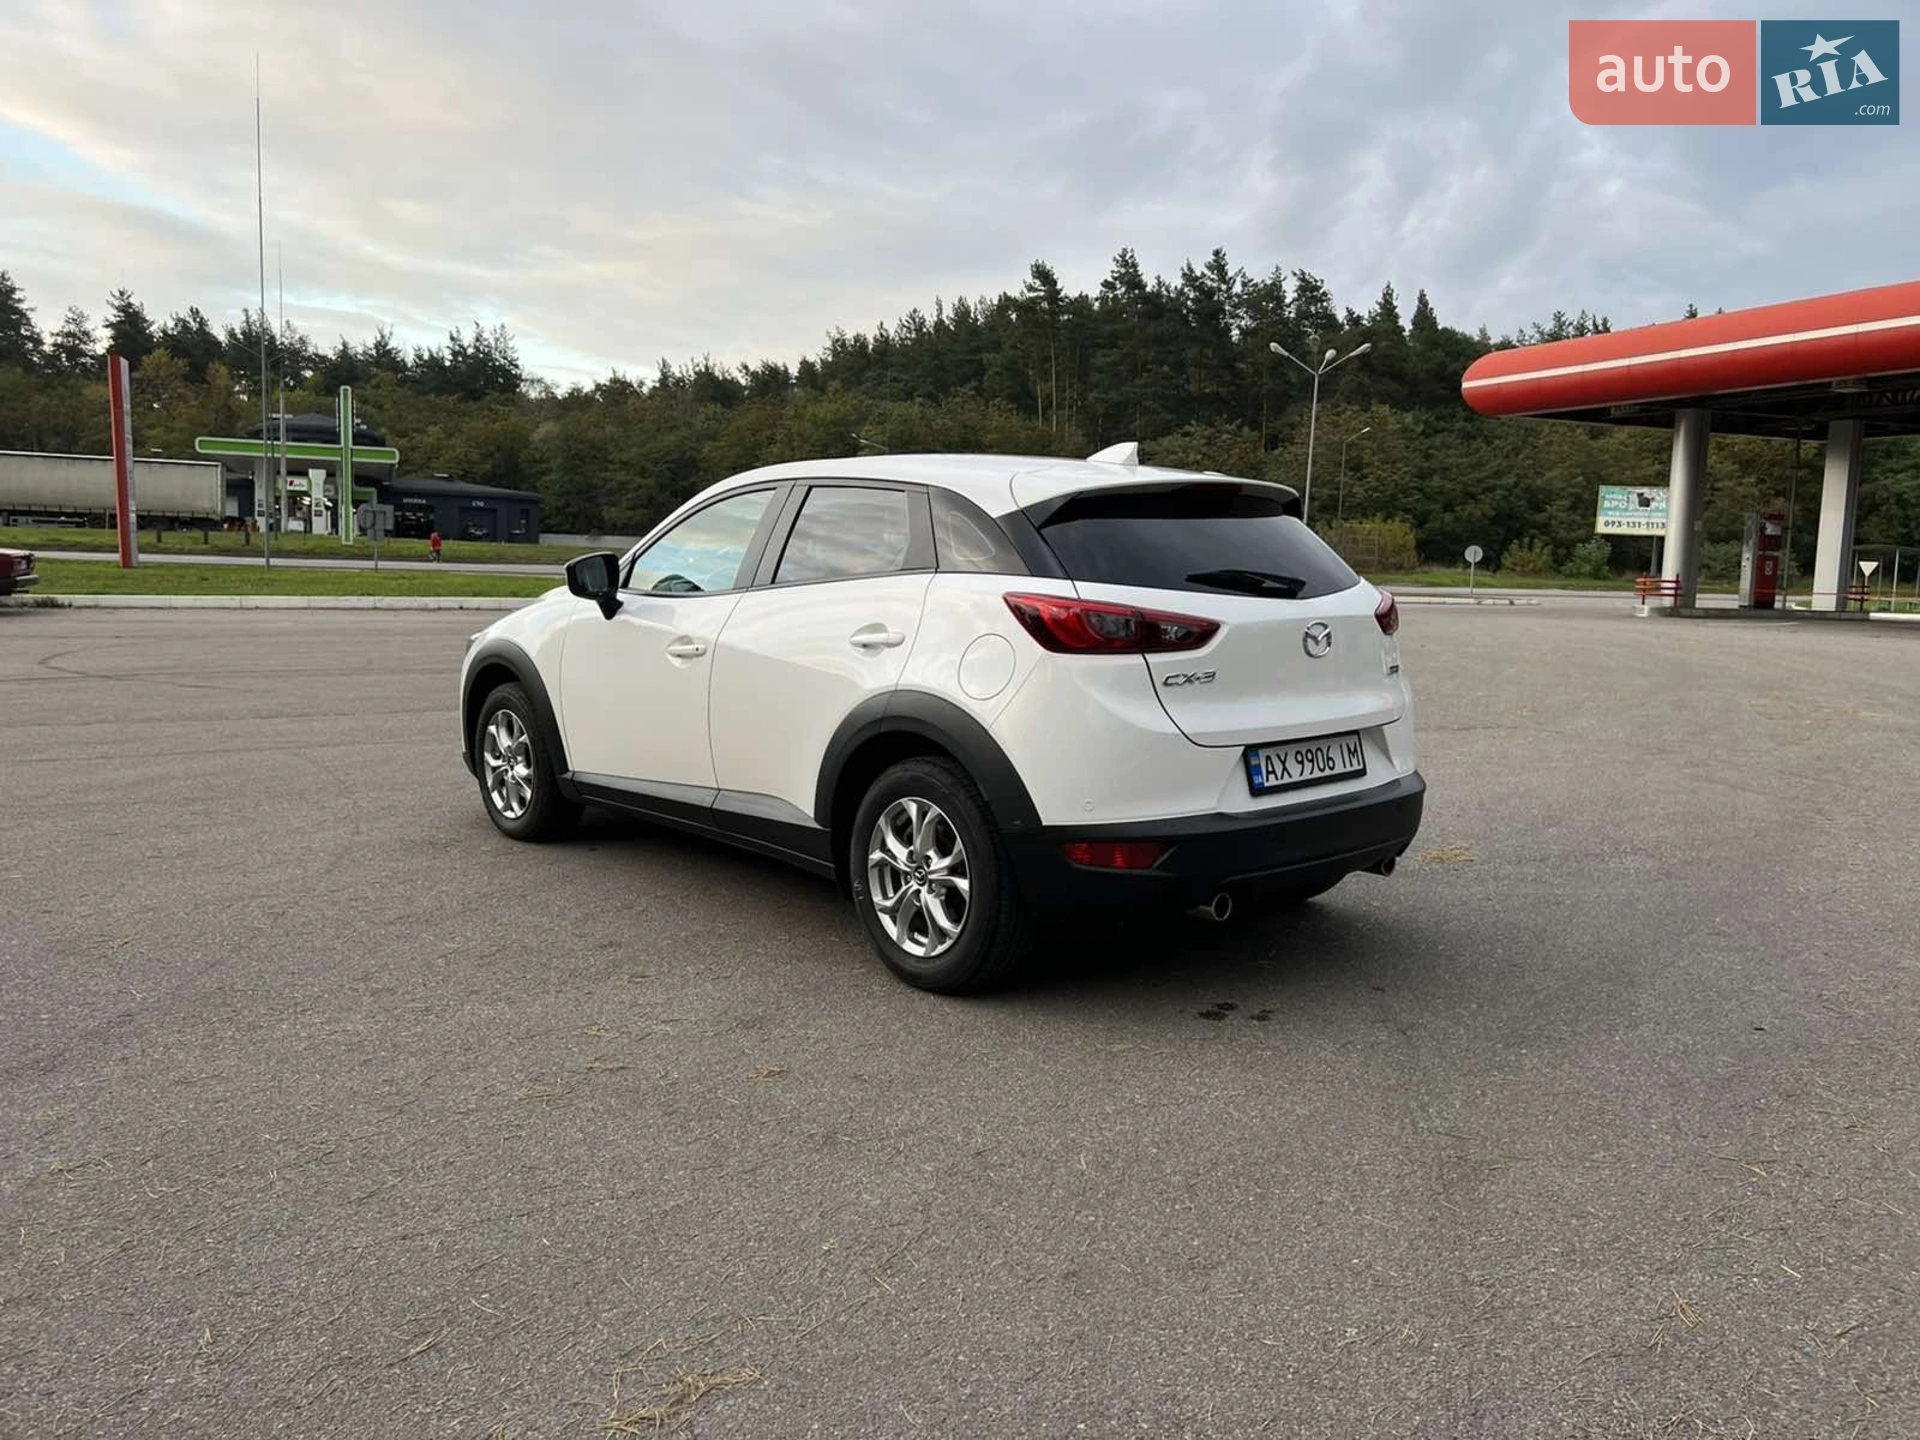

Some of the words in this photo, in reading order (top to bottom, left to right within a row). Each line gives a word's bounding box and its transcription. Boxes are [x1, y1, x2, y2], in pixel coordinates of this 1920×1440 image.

[1162, 671, 1217, 687] CX-3
[1265, 751, 1292, 783] AX
[1294, 745, 1336, 777] 9906
[1339, 741, 1361, 769] IM
